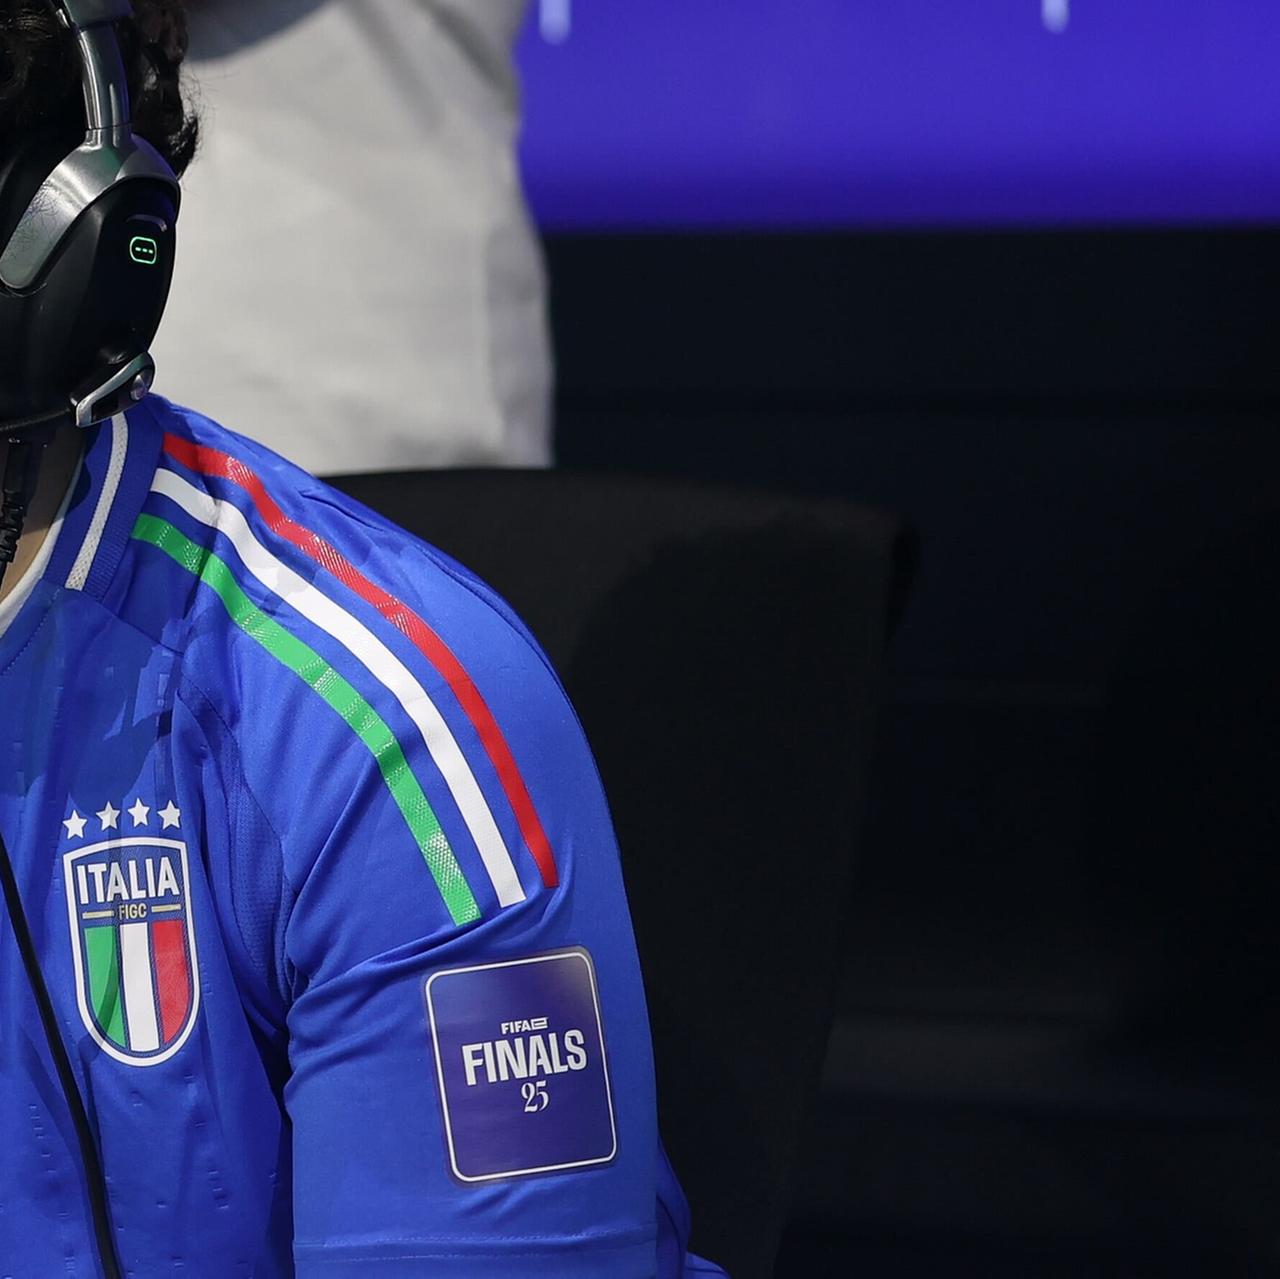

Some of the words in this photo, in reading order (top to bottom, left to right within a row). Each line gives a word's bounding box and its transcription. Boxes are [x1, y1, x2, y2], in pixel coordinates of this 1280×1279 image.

[76, 856, 181, 905] ITALIA
[118, 903, 147, 920] FIGC
[462, 1029, 588, 1087] FINALS
[521, 1080, 550, 1113] 25
